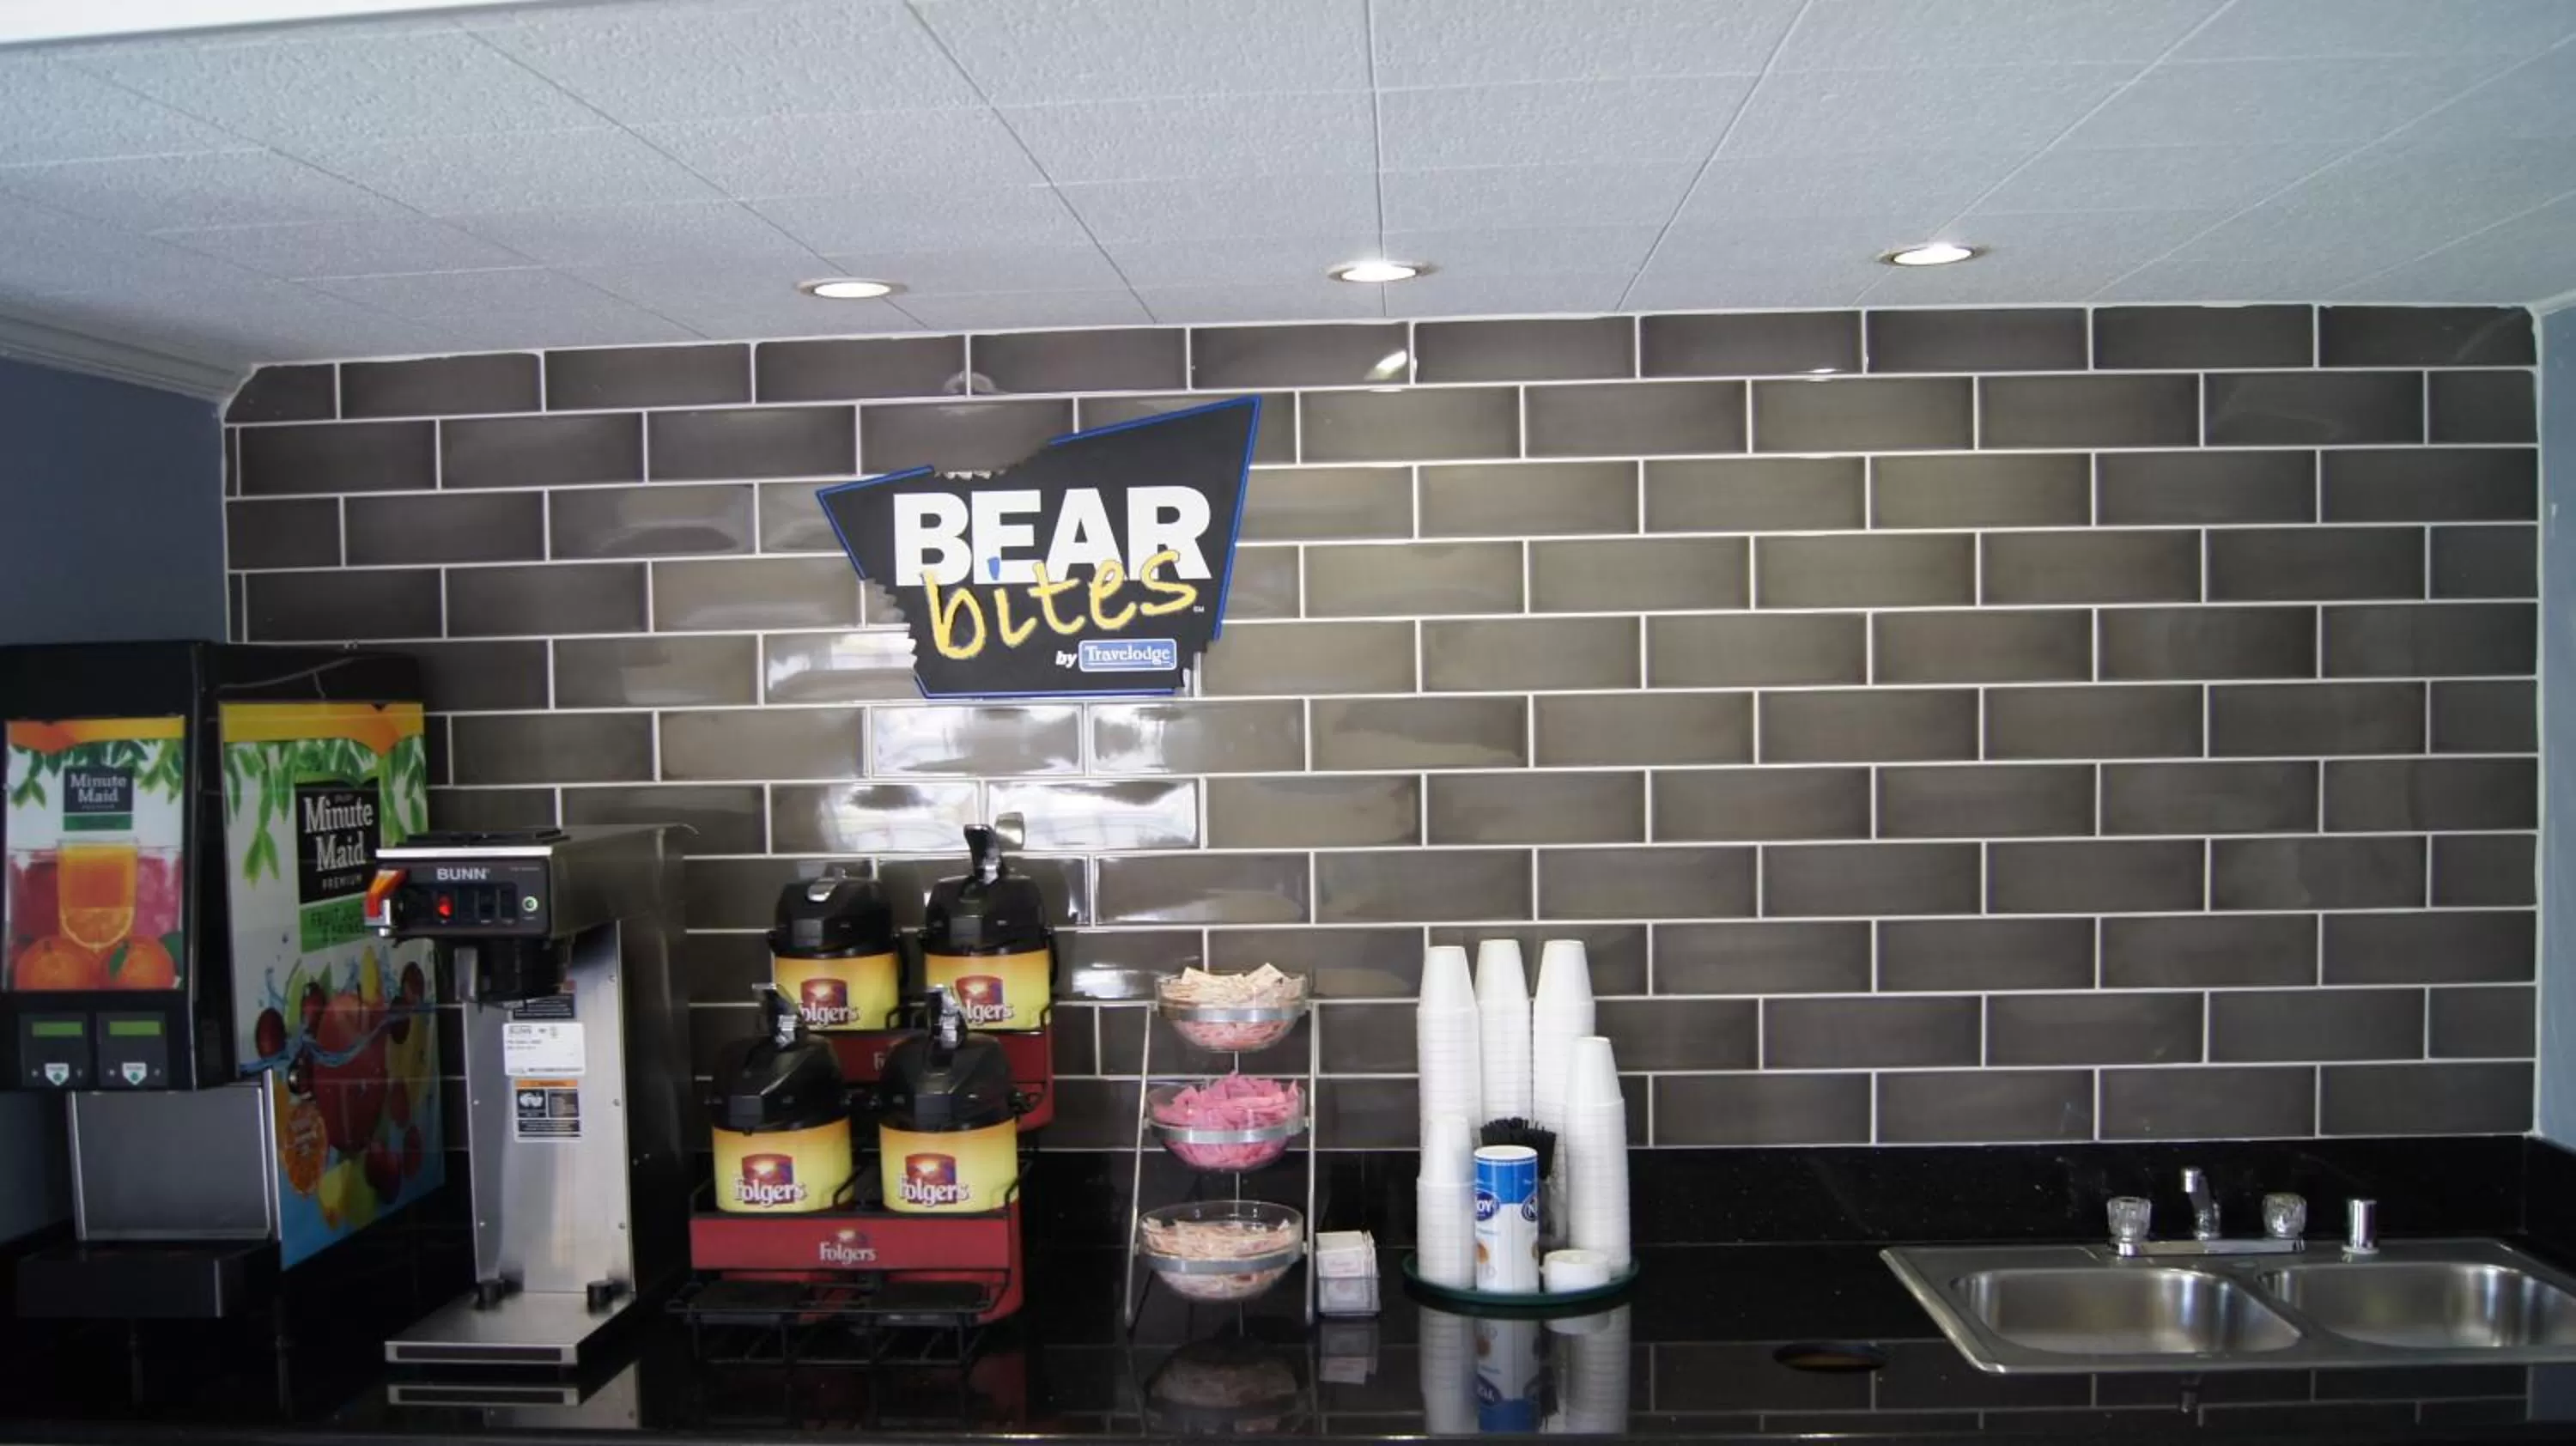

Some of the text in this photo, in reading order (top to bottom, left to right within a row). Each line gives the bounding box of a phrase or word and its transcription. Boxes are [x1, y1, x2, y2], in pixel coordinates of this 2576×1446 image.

[894, 485, 1212, 586] BEAR
[920, 550, 1197, 659] bites
[1055, 644, 1171, 669] by Travelodge
[70, 774, 127, 787] Minute
[77, 787, 118, 803] Maid
[303, 796, 374, 834] Minute
[315, 830, 367, 872] Maid
[436, 868, 488, 880] BUNN
[795, 999, 860, 1025] olgers
[957, 998, 1016, 1024] lgers
[733, 1173, 806, 1206] Folgers
[898, 1174, 971, 1206] Folgers
[819, 1242, 877, 1265] Folgers
